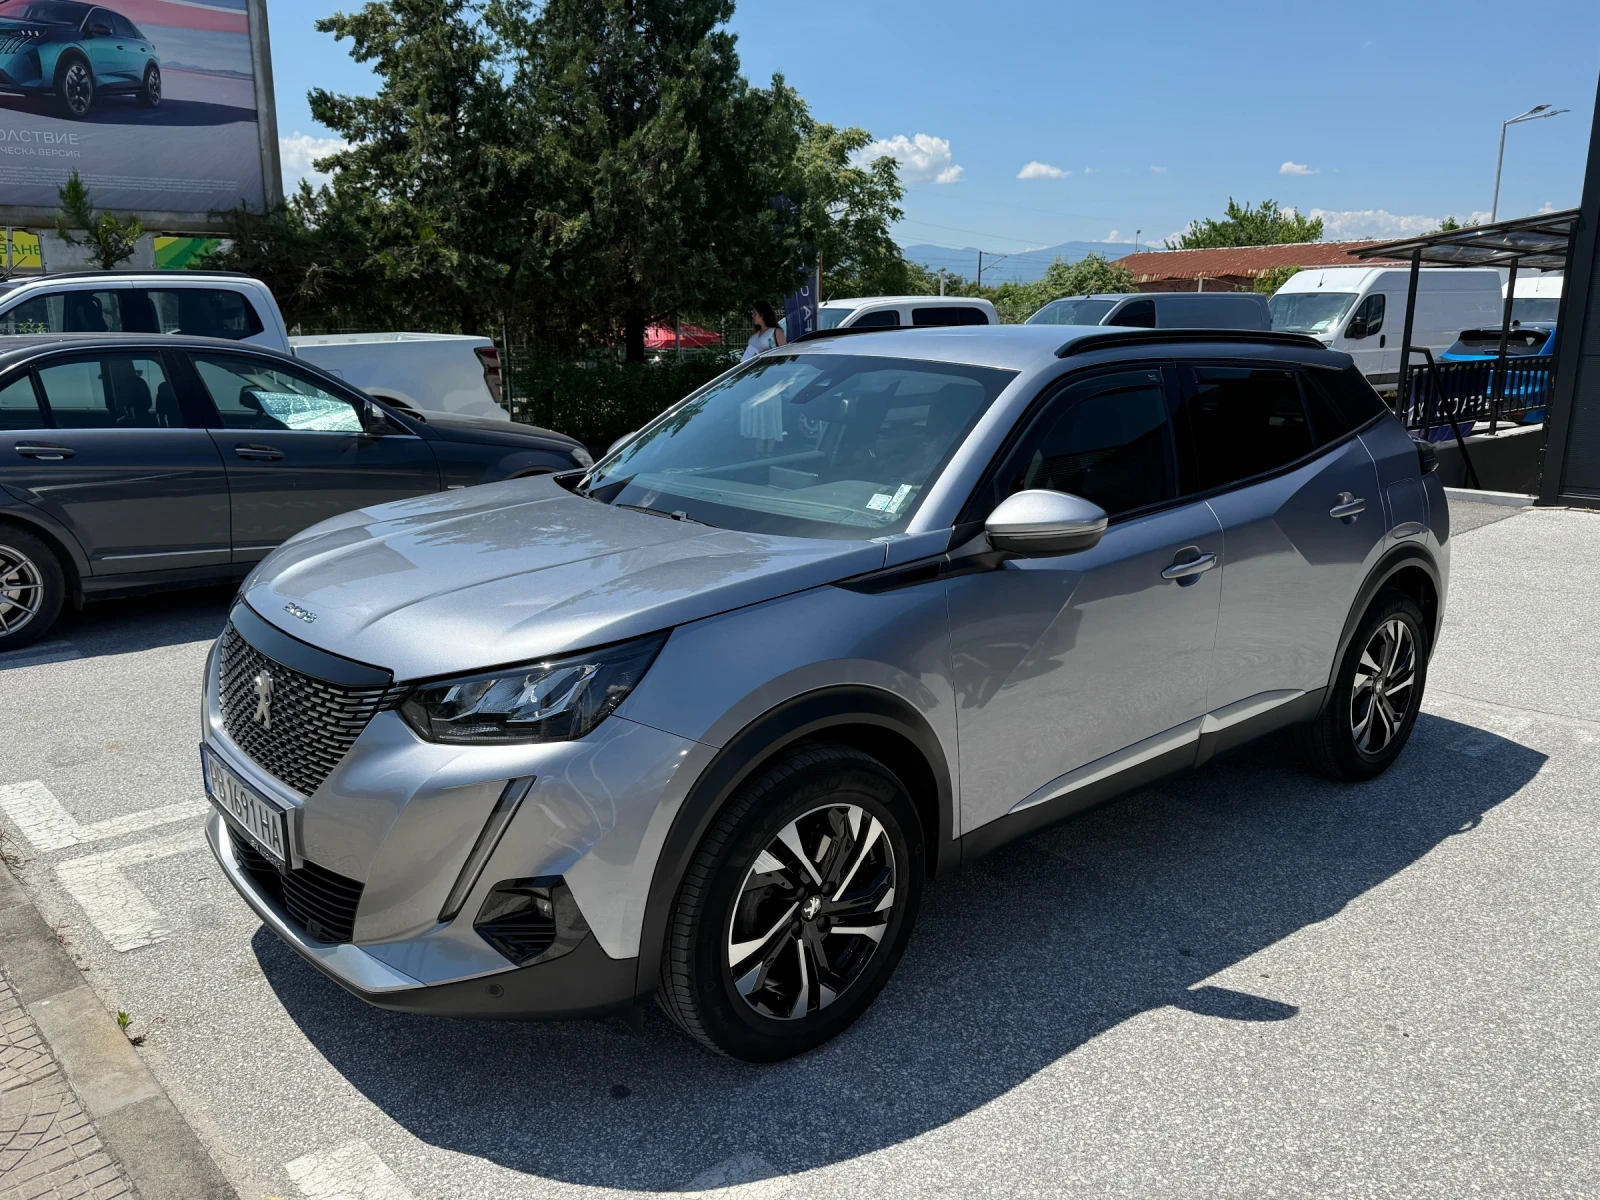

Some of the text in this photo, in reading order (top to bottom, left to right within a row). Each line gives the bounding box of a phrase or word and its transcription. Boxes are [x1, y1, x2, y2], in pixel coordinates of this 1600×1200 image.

[38, 148, 81, 158] ВЕРСИЯ
[283, 601, 318, 623] 2008
[227, 778, 258, 833] 1691
